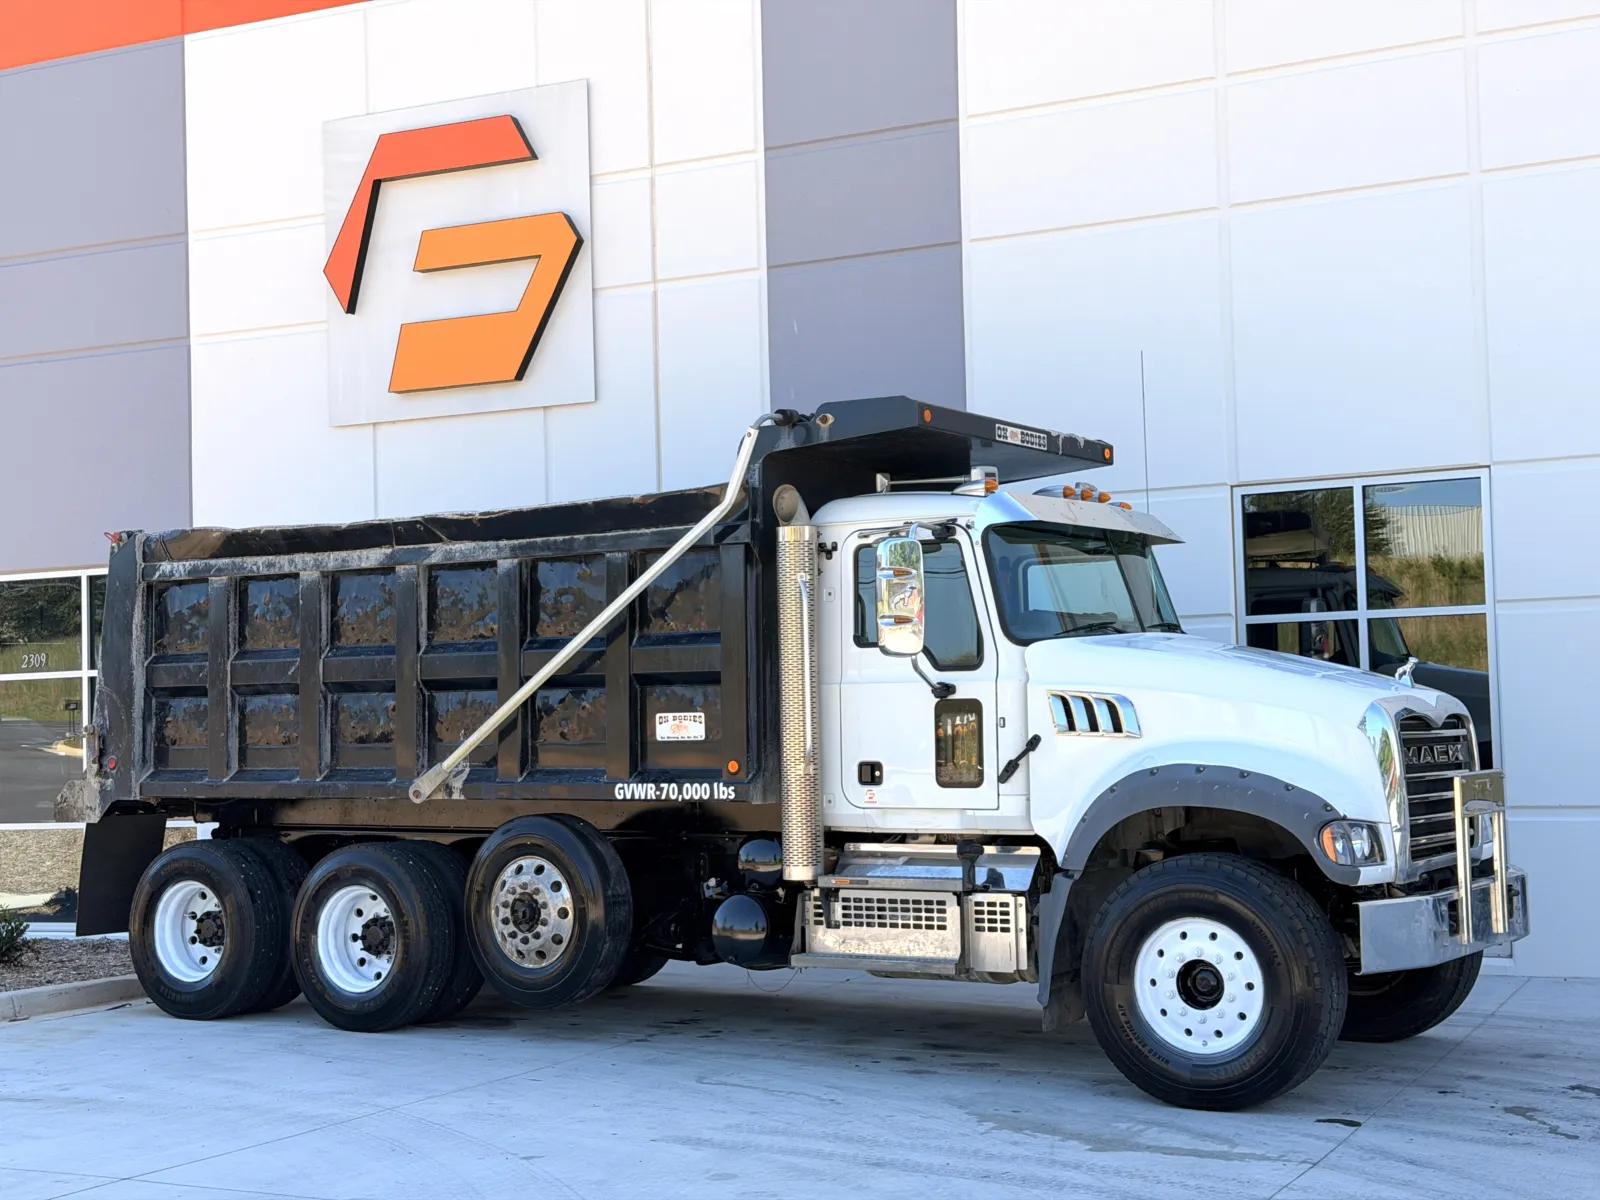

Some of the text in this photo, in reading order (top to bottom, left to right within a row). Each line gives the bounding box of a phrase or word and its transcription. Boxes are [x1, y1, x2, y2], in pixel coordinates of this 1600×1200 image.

[1020, 431, 1046, 448] BODIES
[21, 653, 46, 668] 2309
[672, 715, 703, 725] BODIES
[614, 782, 736, 801] GVWR-70,000 lbs
